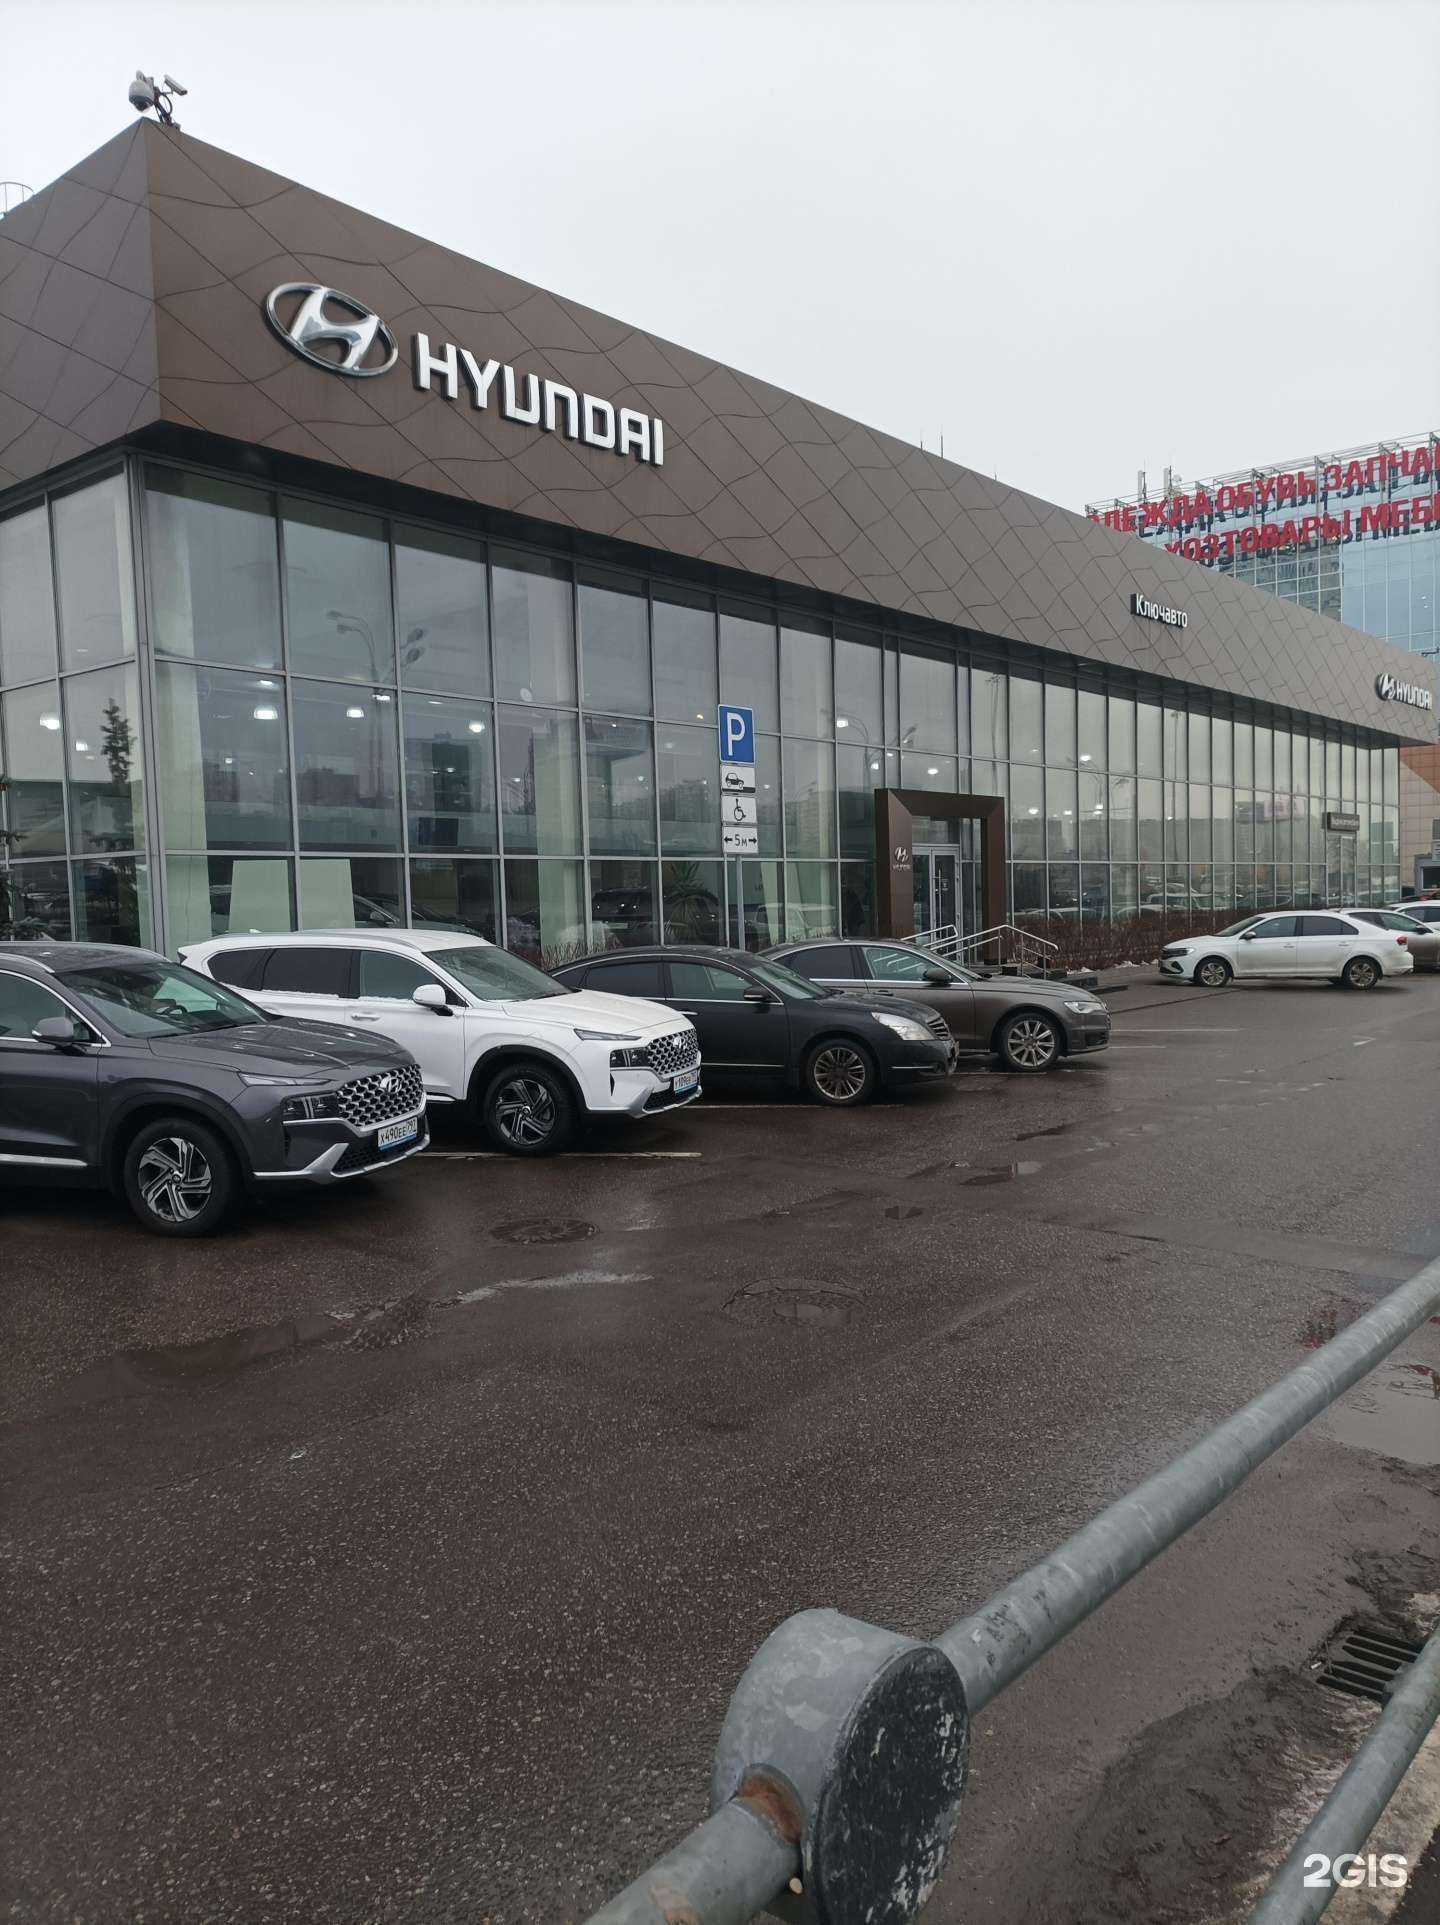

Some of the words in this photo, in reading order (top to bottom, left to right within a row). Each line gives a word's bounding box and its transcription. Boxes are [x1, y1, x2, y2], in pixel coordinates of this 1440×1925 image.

[414, 332, 664, 466] HYUNDAI
[1215, 471, 1316, 512] ОБУВЬ
[1323, 441, 1440, 490] ЗАПЧА
[1360, 491, 1440, 533] МЕБ
[1136, 593, 1188, 628] Ключавто
[1396, 680, 1432, 710] HYUNDAI
[726, 711, 746, 757] P
